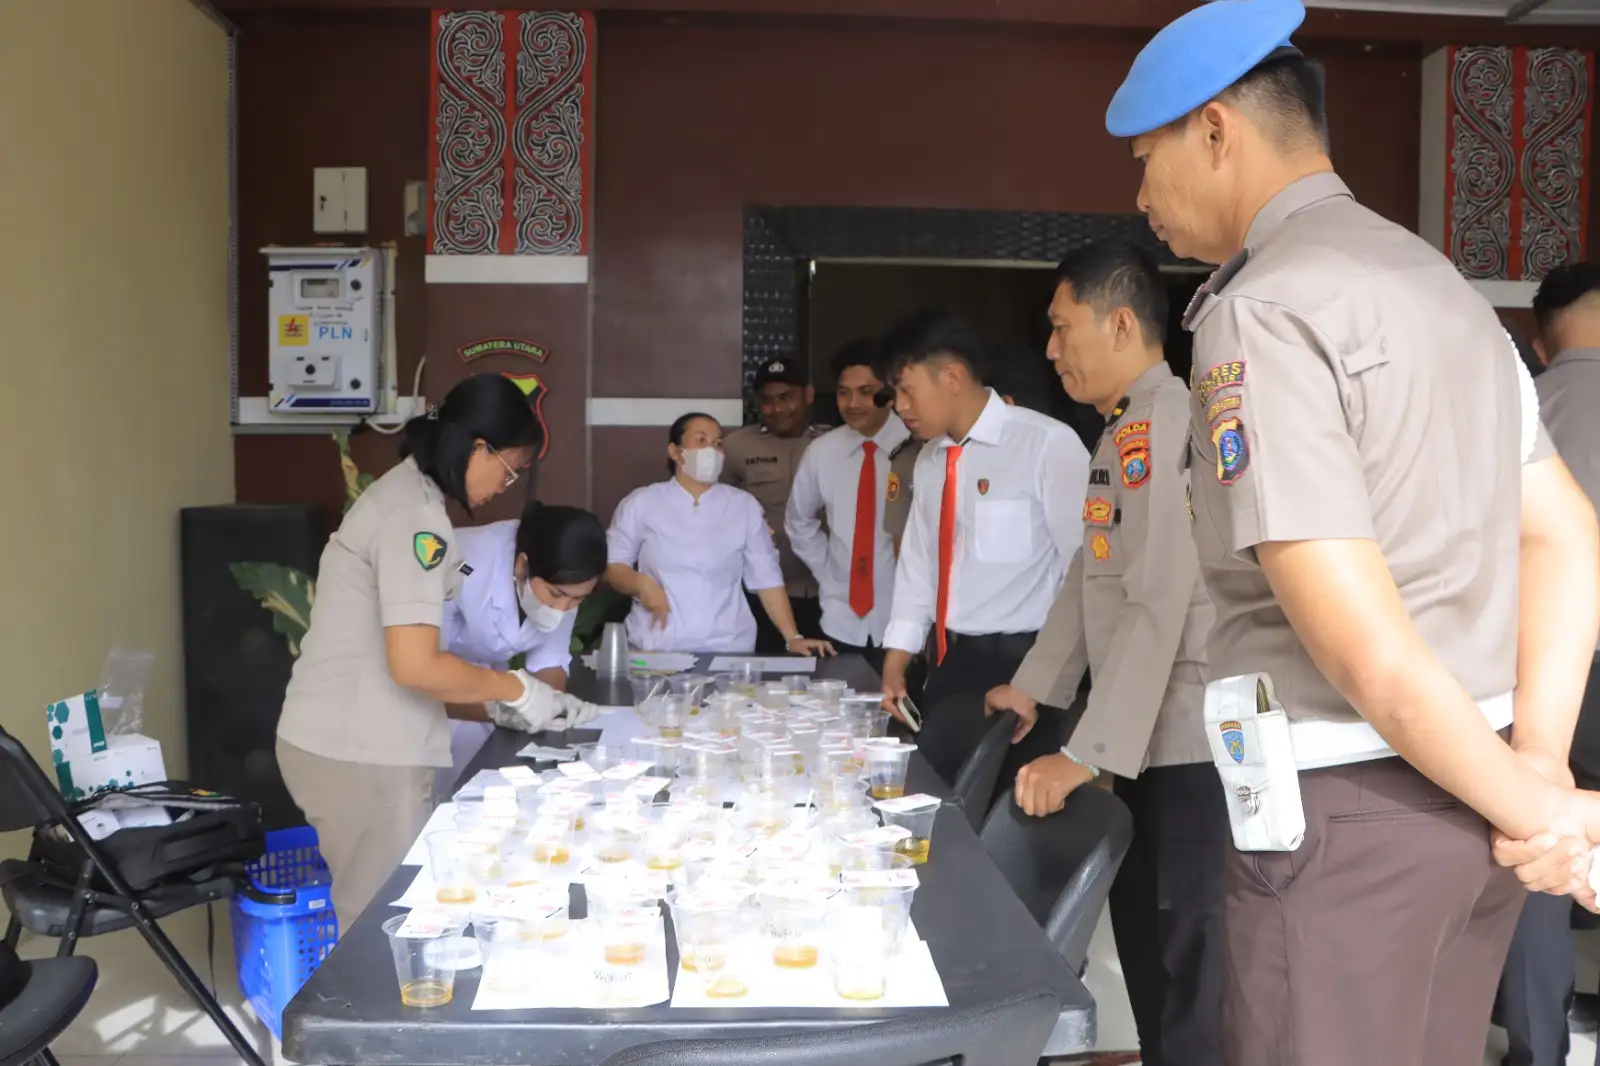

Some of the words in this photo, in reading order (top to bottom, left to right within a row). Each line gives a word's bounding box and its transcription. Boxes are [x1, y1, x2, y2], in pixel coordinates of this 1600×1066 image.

[319, 326, 352, 339] PLN
[463, 341, 512, 357] SUMATERA
[514, 343, 542, 357] UTARA
[1116, 423, 1147, 442] POLDA
